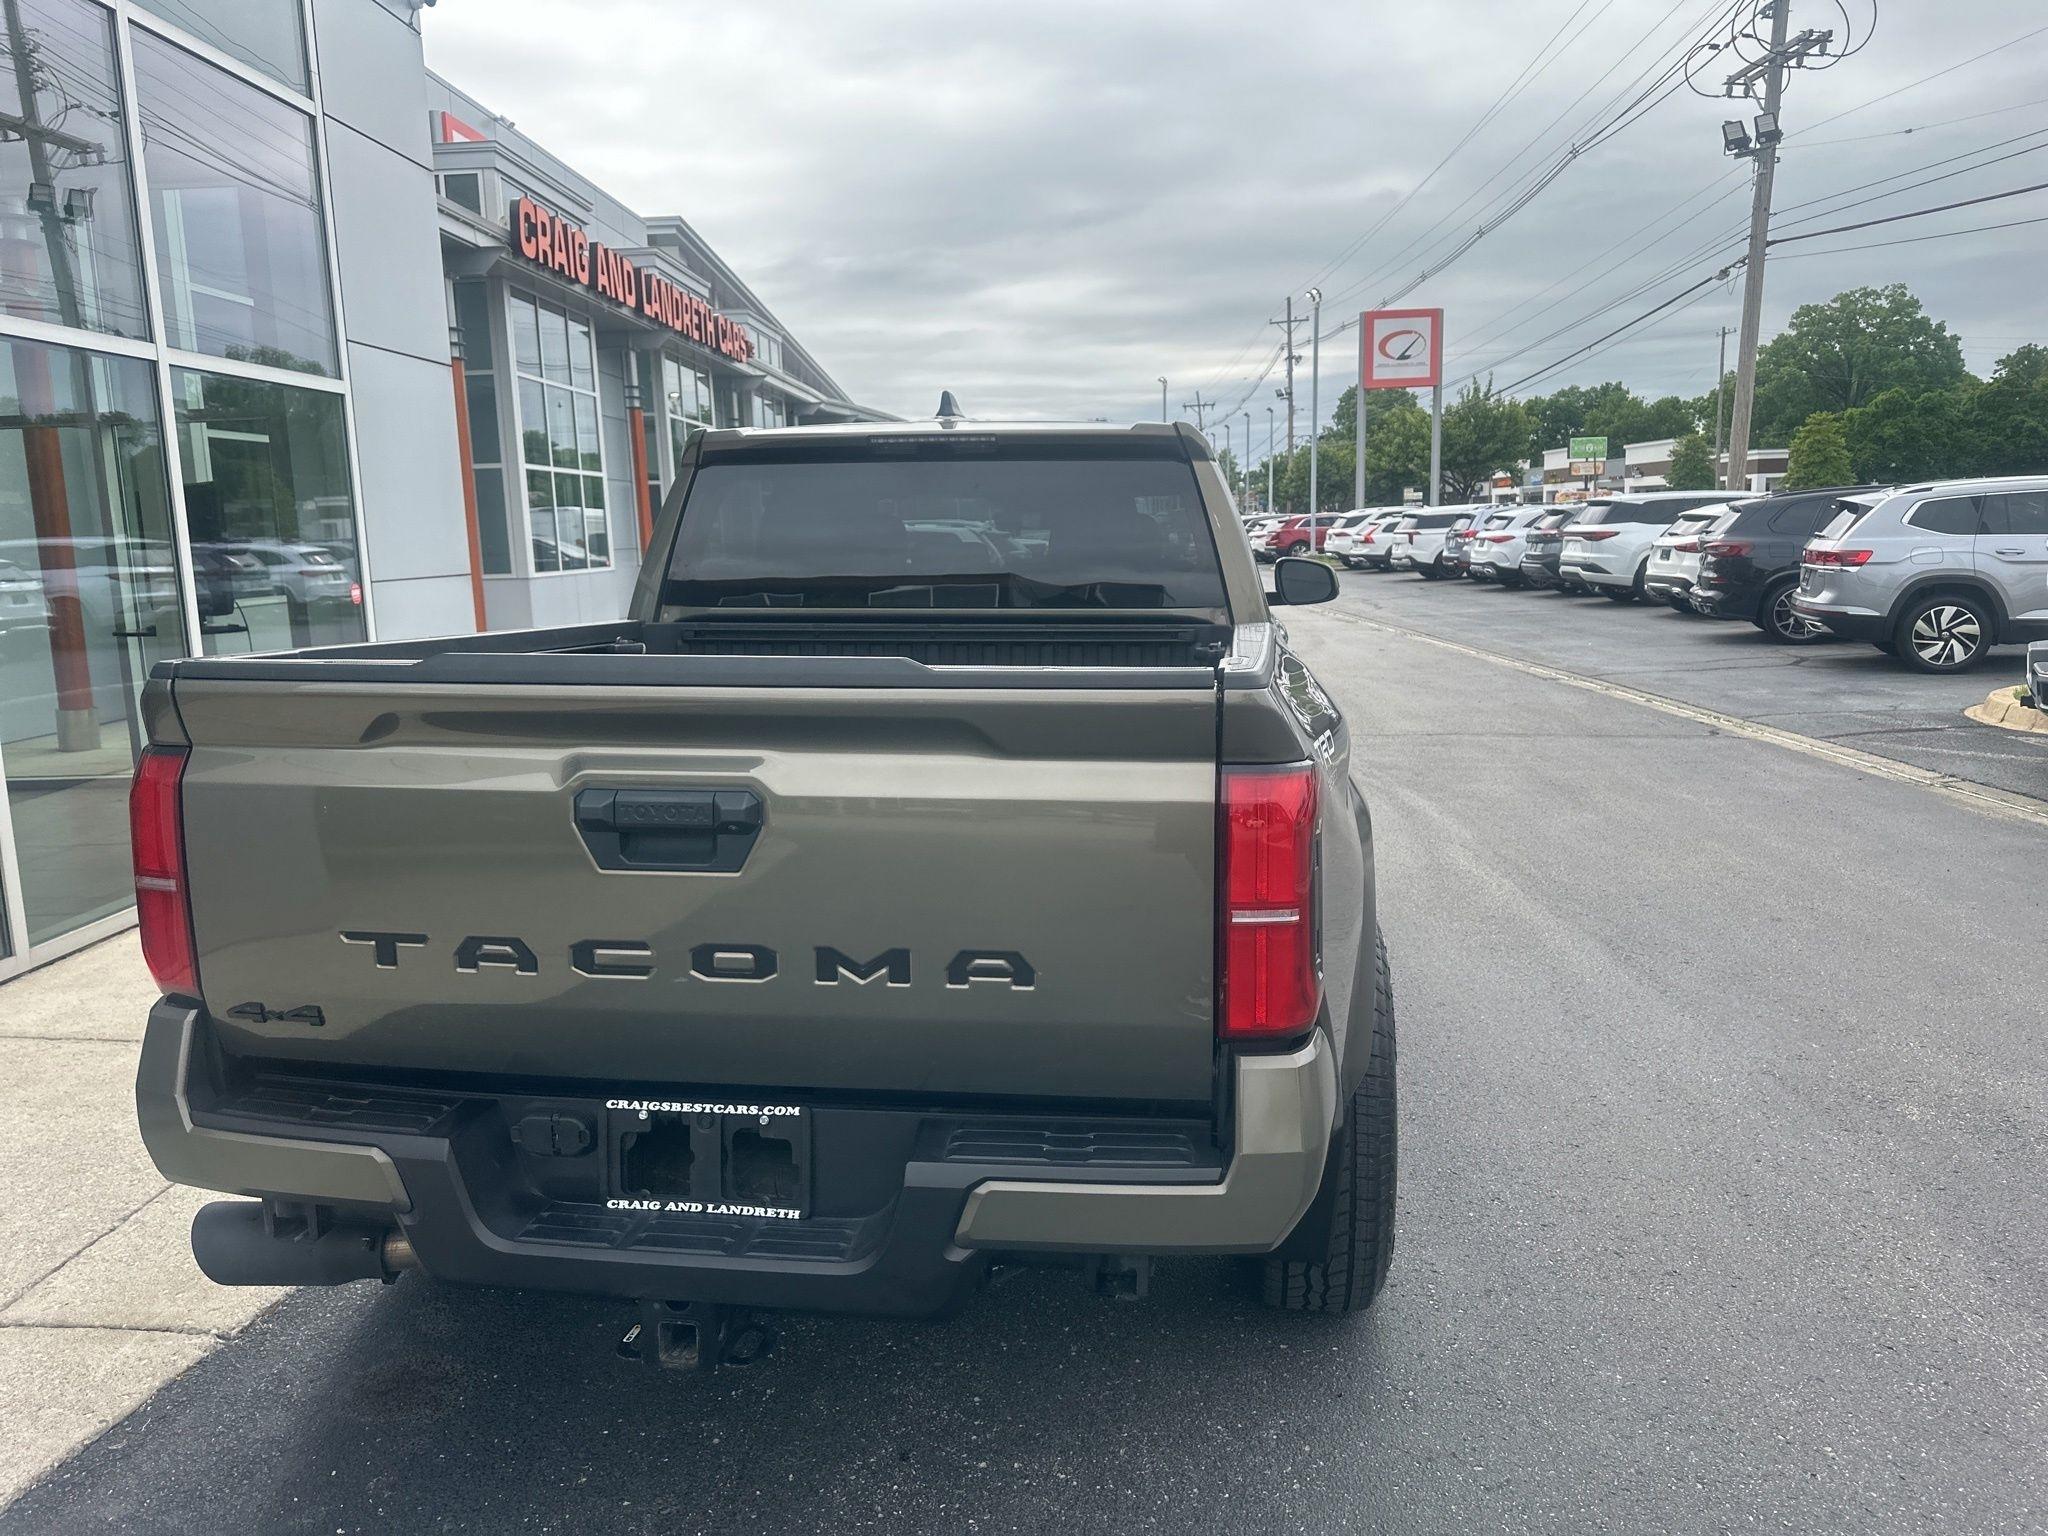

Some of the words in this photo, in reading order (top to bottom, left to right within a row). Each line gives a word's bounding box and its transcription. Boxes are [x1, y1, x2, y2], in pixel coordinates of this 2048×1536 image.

[517, 196, 590, 286] CRAIG
[597, 242, 637, 309] AND
[640, 266, 717, 349] LANDRETH
[718, 313, 748, 364] CARS
[619, 803, 710, 823] TOYOTA
[338, 929, 1038, 992] TACOMA
[605, 1099, 801, 1116] CRAIGSBESTCARS.COM
[605, 1198, 662, 1212] CRAIG
[664, 1200, 704, 1213] AND
[707, 1203, 801, 1220] LANDRETH
